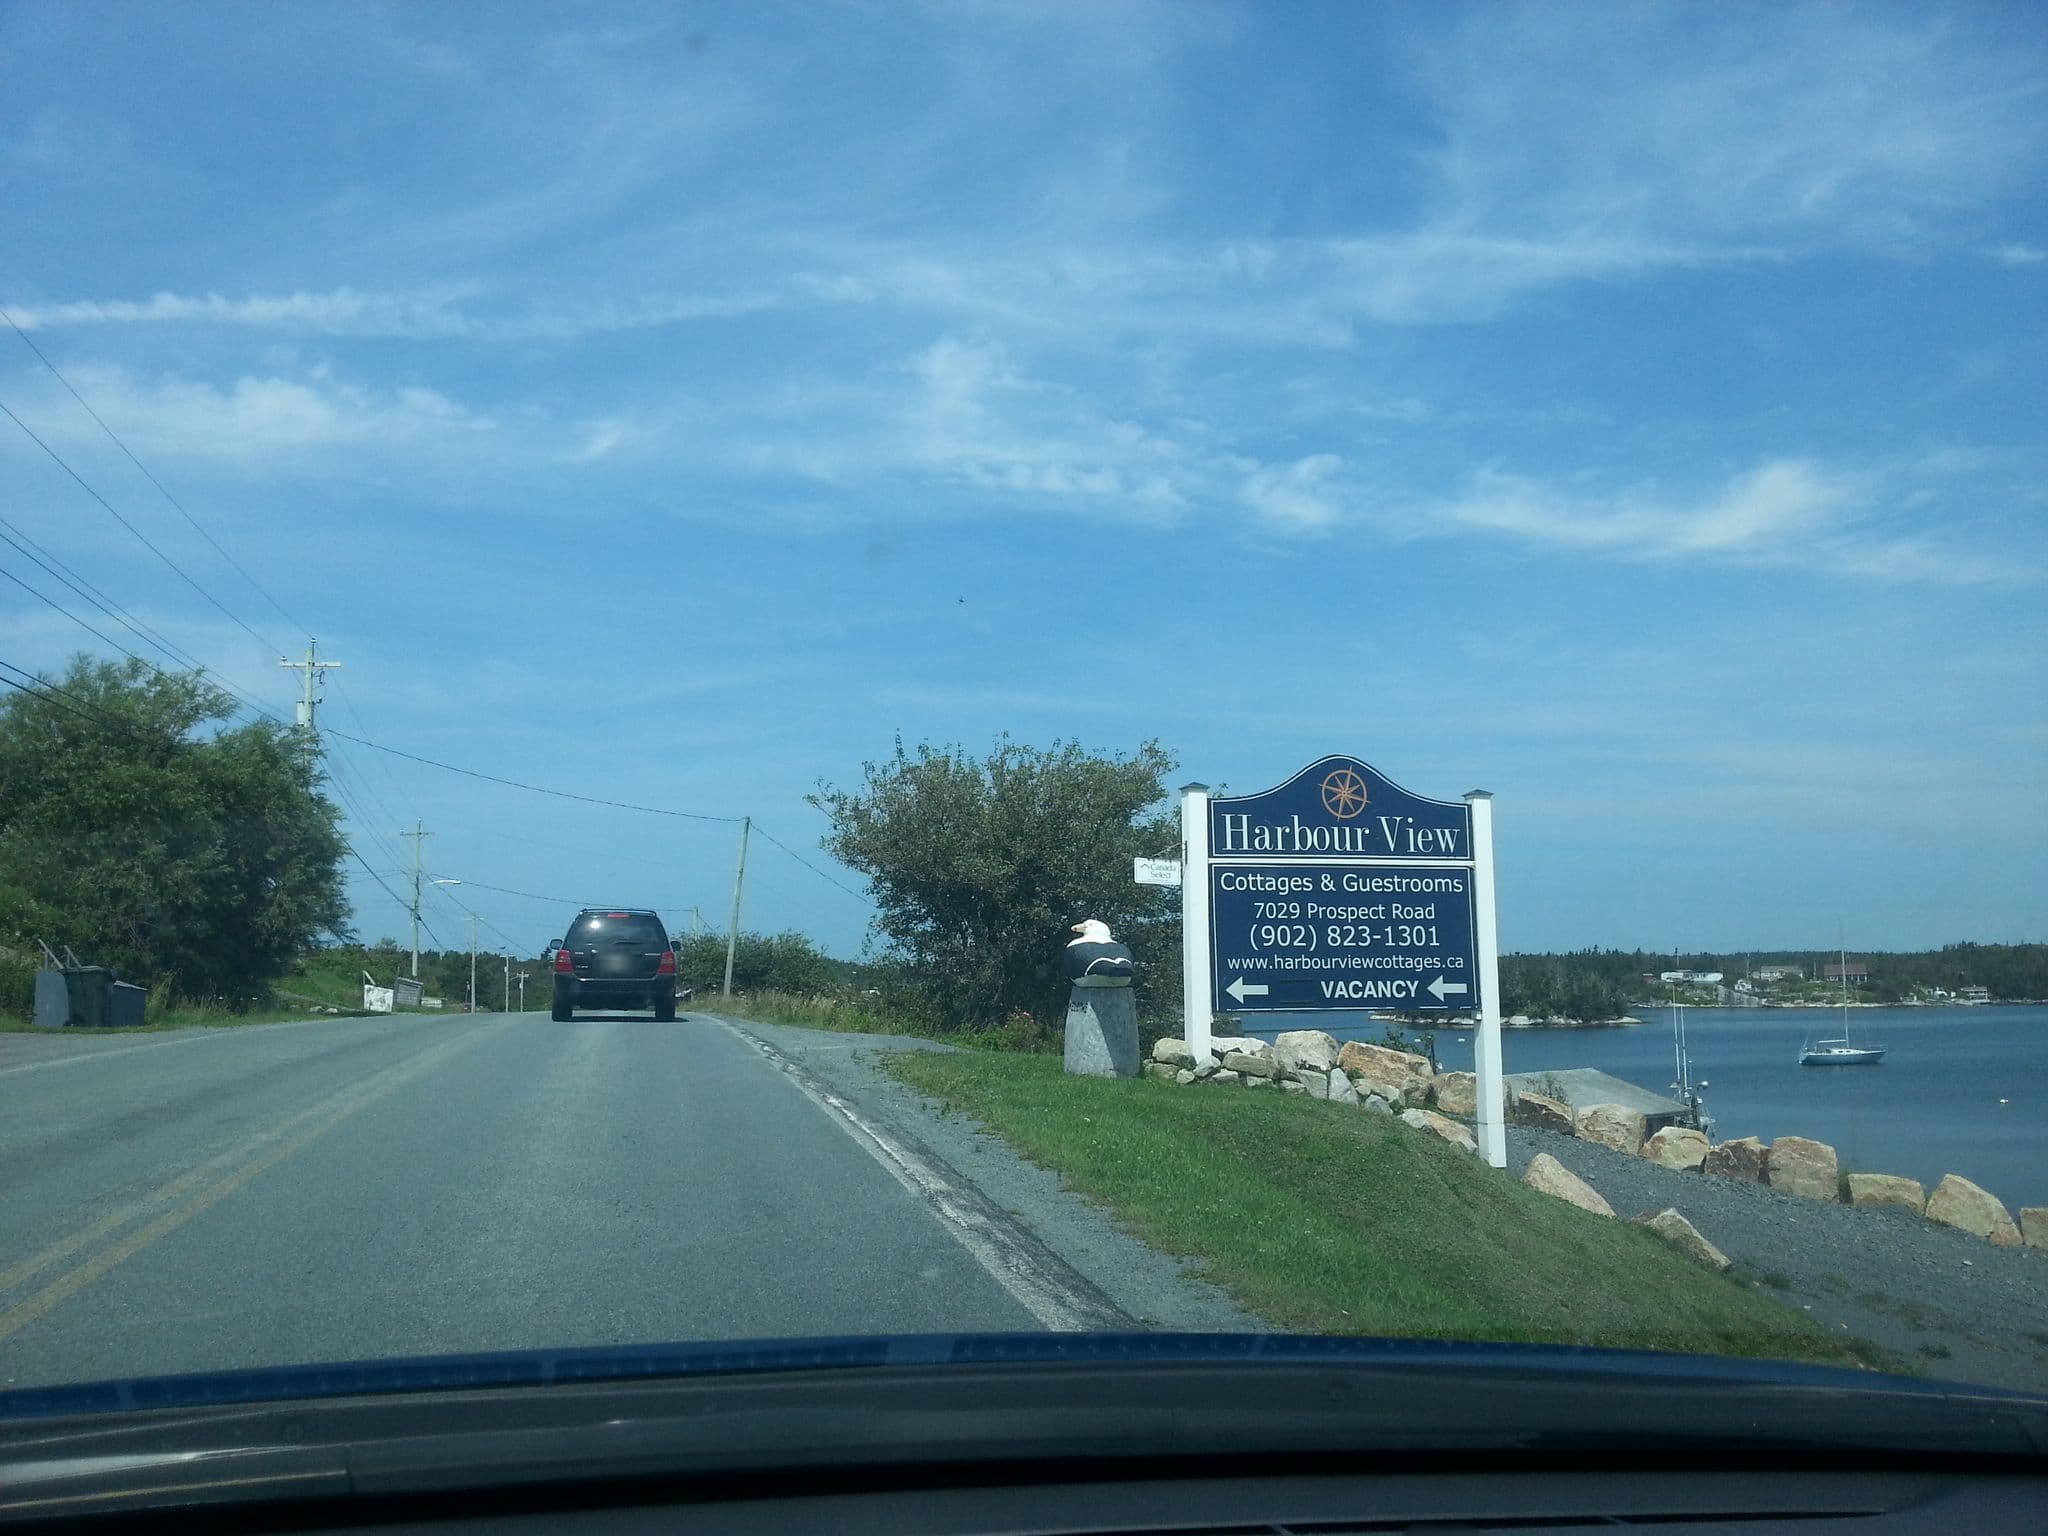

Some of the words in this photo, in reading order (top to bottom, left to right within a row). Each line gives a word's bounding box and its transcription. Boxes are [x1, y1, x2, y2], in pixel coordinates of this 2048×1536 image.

[1221, 814, 1370, 852] Harbour
[1376, 816, 1460, 854] View
[1221, 872, 1313, 895] Cottages
[1320, 873, 1336, 891] &
[1343, 873, 1463, 893] Guestrooms
[1254, 903, 1300, 919] 7029
[1308, 903, 1385, 922] Prospect
[1392, 904, 1435, 920] Road
[1250, 924, 1317, 951] (902)
[1327, 925, 1440, 946] 823-1301
[1227, 954, 1464, 972] www.harbourviewcottages.ca
[1321, 980, 1419, 999] VACANCY
